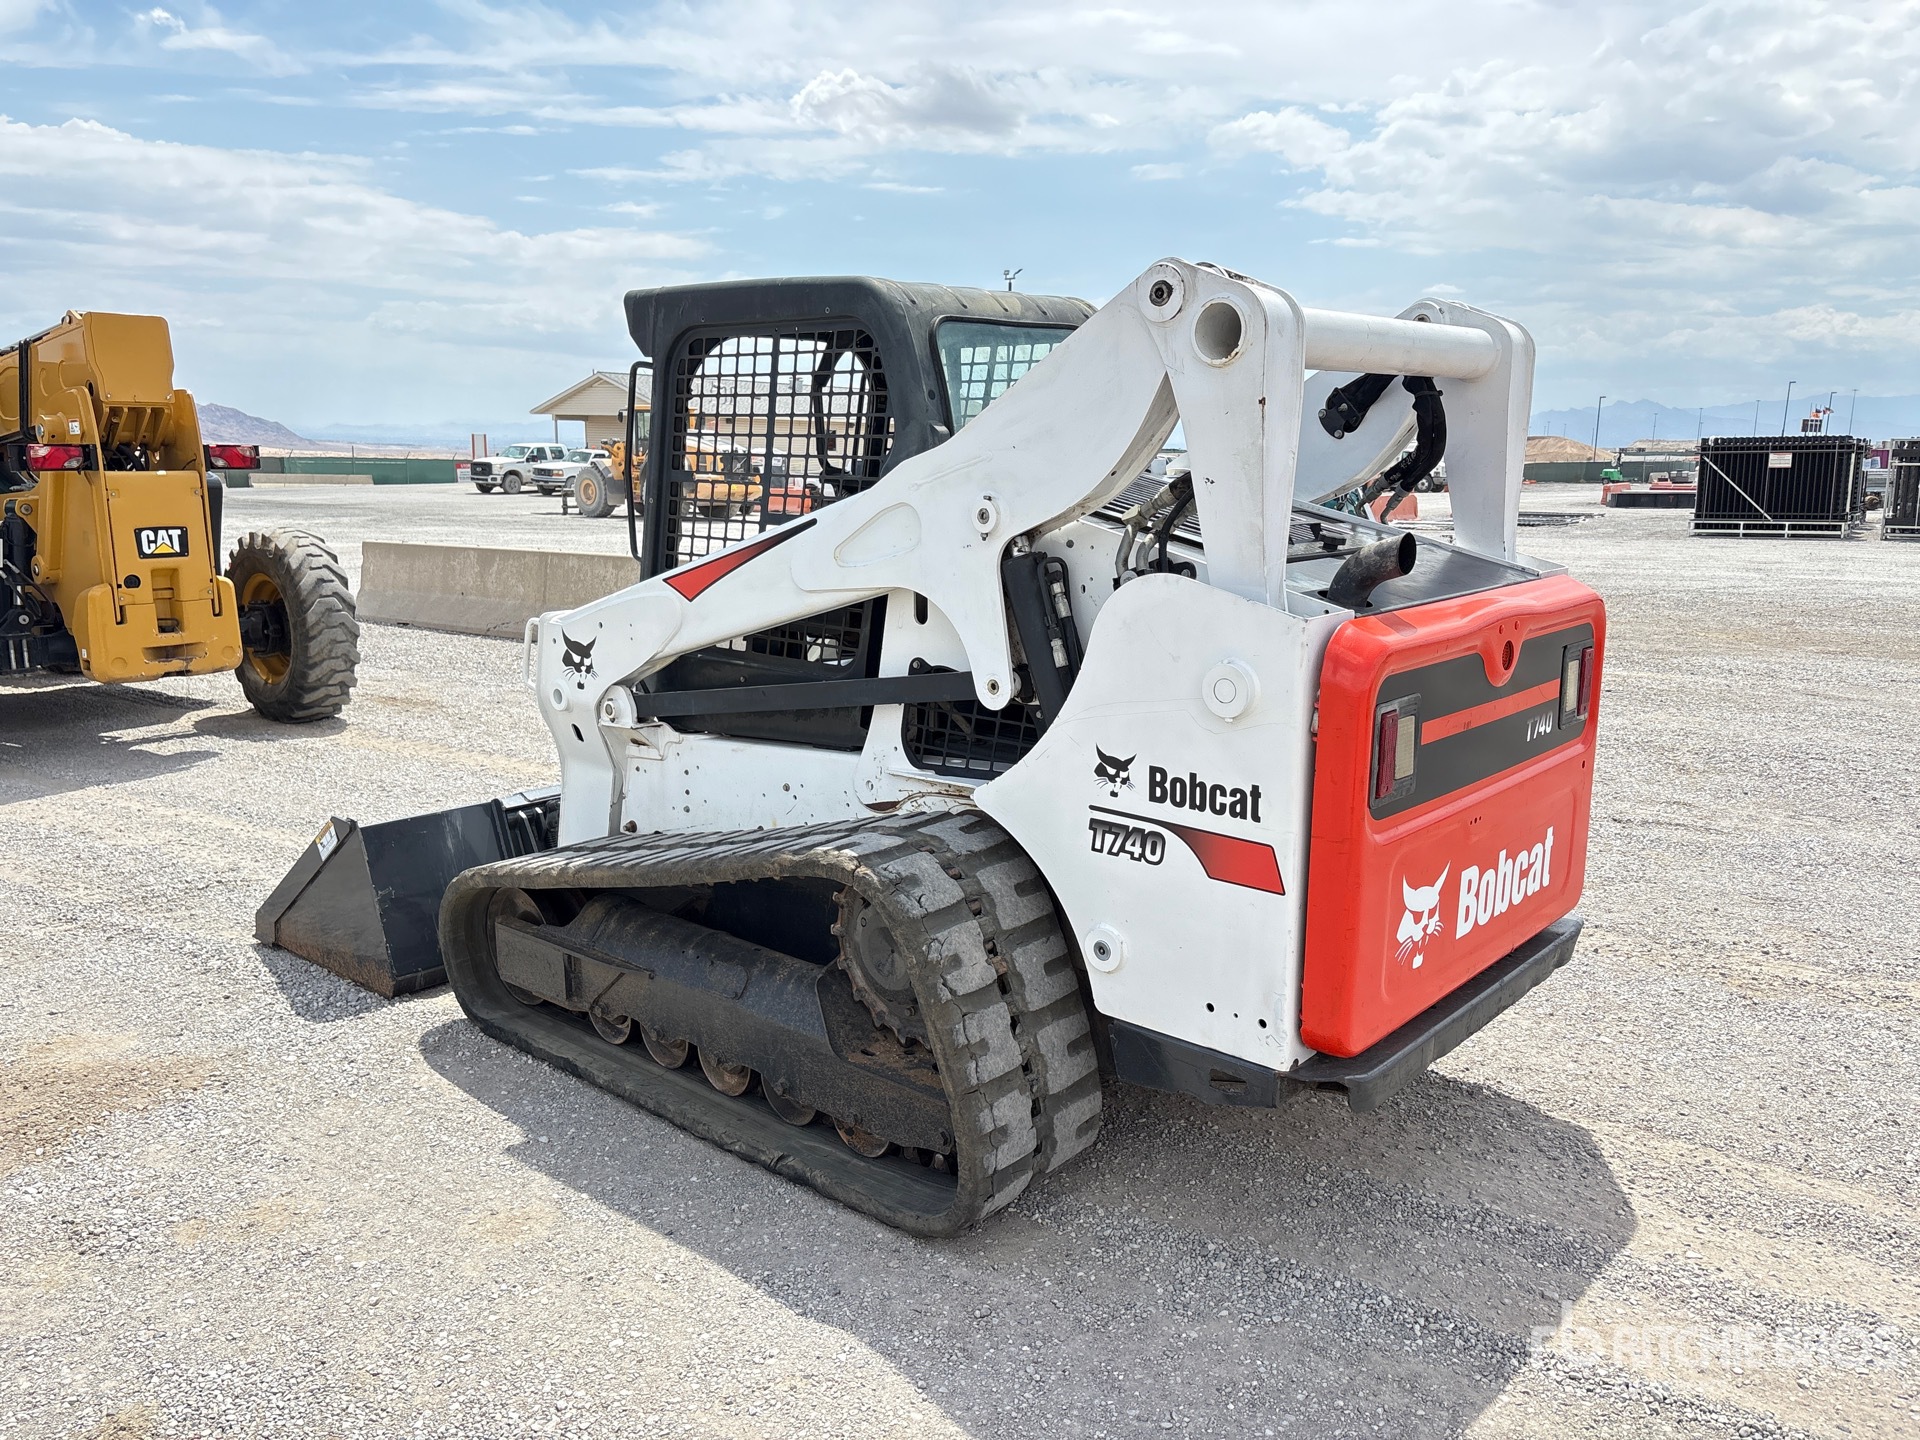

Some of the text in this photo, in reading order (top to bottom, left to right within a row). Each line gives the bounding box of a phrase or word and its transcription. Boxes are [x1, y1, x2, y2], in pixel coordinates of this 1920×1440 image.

[141, 529, 181, 554] CAT
[1526, 711, 1553, 742] T740
[1148, 765, 1262, 823] Bobcat
[1089, 818, 1166, 866] T740
[1456, 825, 1554, 940] Bobcat
